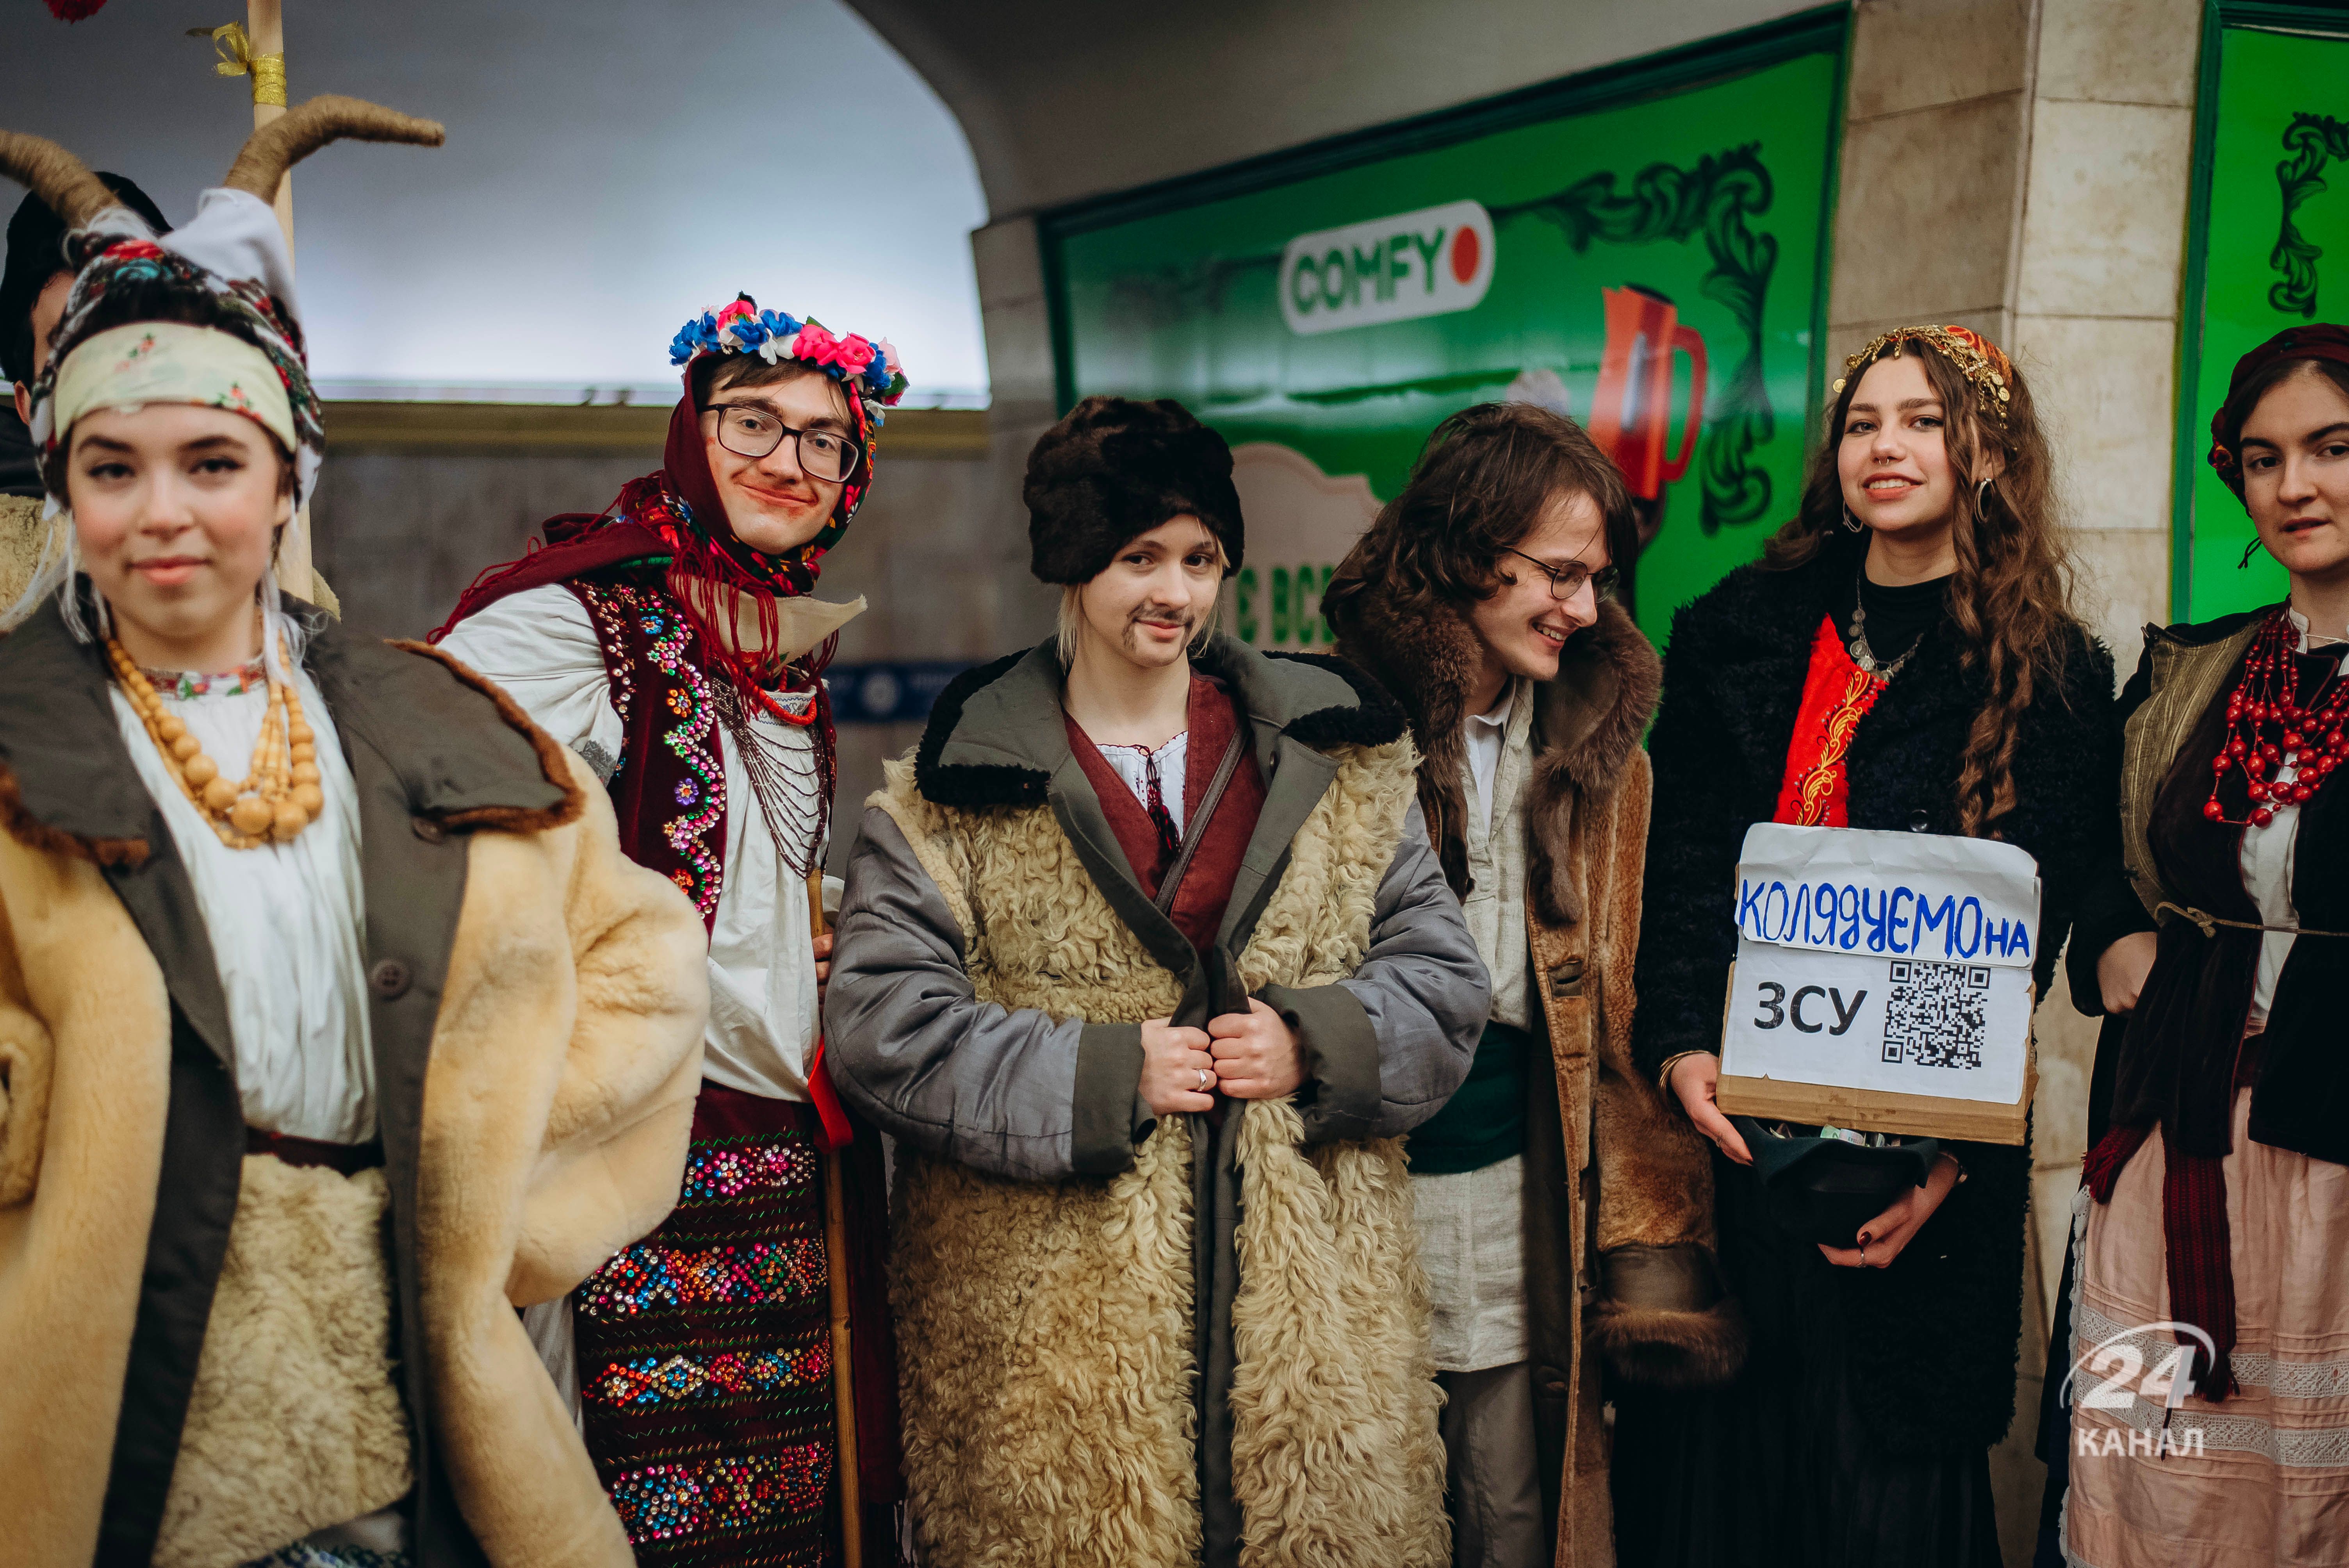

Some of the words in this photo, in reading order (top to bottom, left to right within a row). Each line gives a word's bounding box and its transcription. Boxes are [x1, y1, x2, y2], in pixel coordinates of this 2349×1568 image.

[1291, 225, 1445, 315] COMFY
[1739, 878, 1983, 960] КОЛЯДУЄМО
[1753, 981, 1868, 1036] ЗСУ
